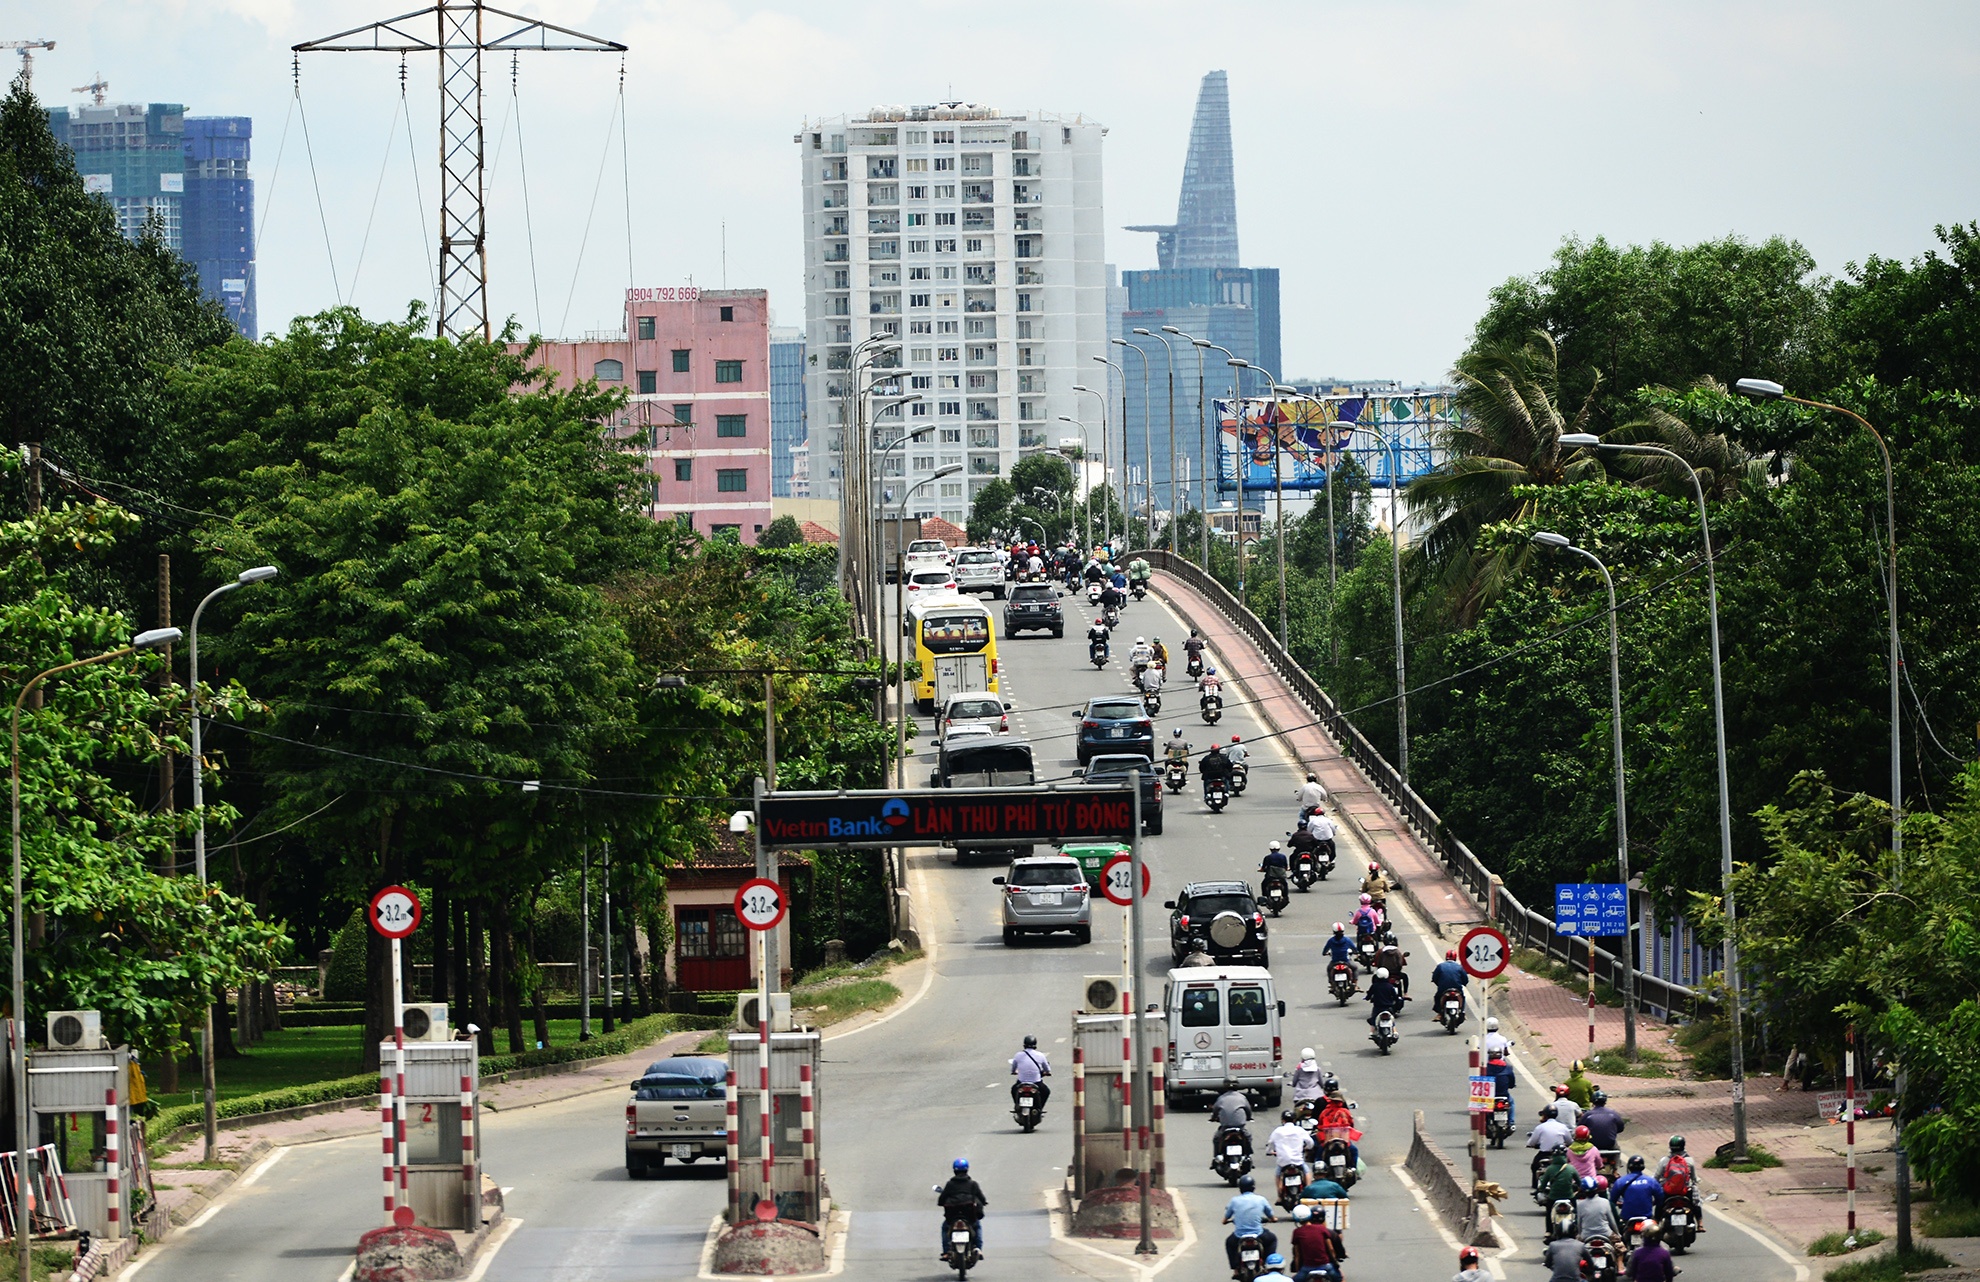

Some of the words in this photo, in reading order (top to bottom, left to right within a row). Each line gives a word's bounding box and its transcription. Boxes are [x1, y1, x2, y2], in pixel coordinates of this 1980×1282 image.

[627, 288, 653, 300] 0904
[656, 287, 675, 300] 792
[678, 287, 697, 300] 666
[914, 801, 954, 833] LÀN
[959, 805, 998, 833] THU
[1005, 798, 1037, 831] PHÍ
[1043, 799, 1071, 836] TỰ
[1075, 796, 1130, 835] ĐỘNG
[765, 816, 883, 837] VietinBank
[1113, 1073, 1123, 1089] 4
[1472, 1081, 1490, 1097] 239
[70, 1112, 78, 1131] 1
[422, 1103, 433, 1122] 2
